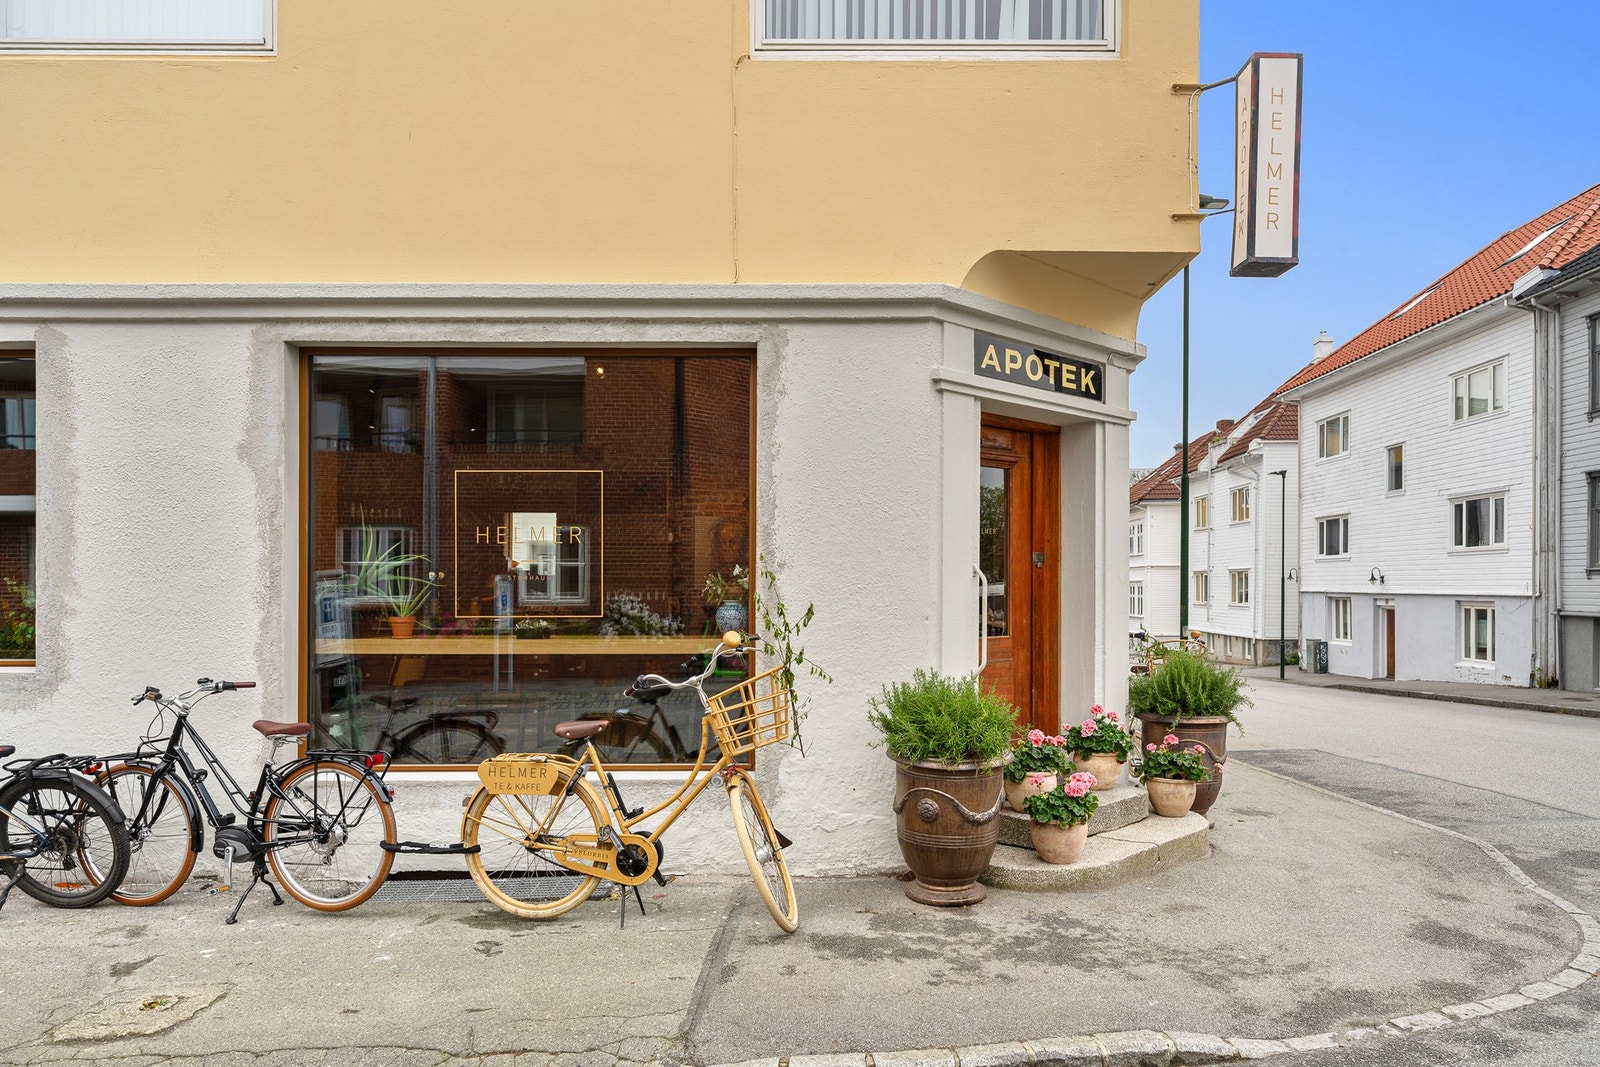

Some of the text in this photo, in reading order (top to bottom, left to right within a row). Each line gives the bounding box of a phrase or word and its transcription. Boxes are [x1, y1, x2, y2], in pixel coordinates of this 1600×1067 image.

[1238, 97, 1248, 240] APOTEK
[1266, 87, 1284, 230] HELMER
[980, 344, 1097, 395] APOTEK
[476, 526, 582, 544] HELMER
[488, 767, 548, 779] HELMER
[494, 782, 541, 792] TE & KAFFE
